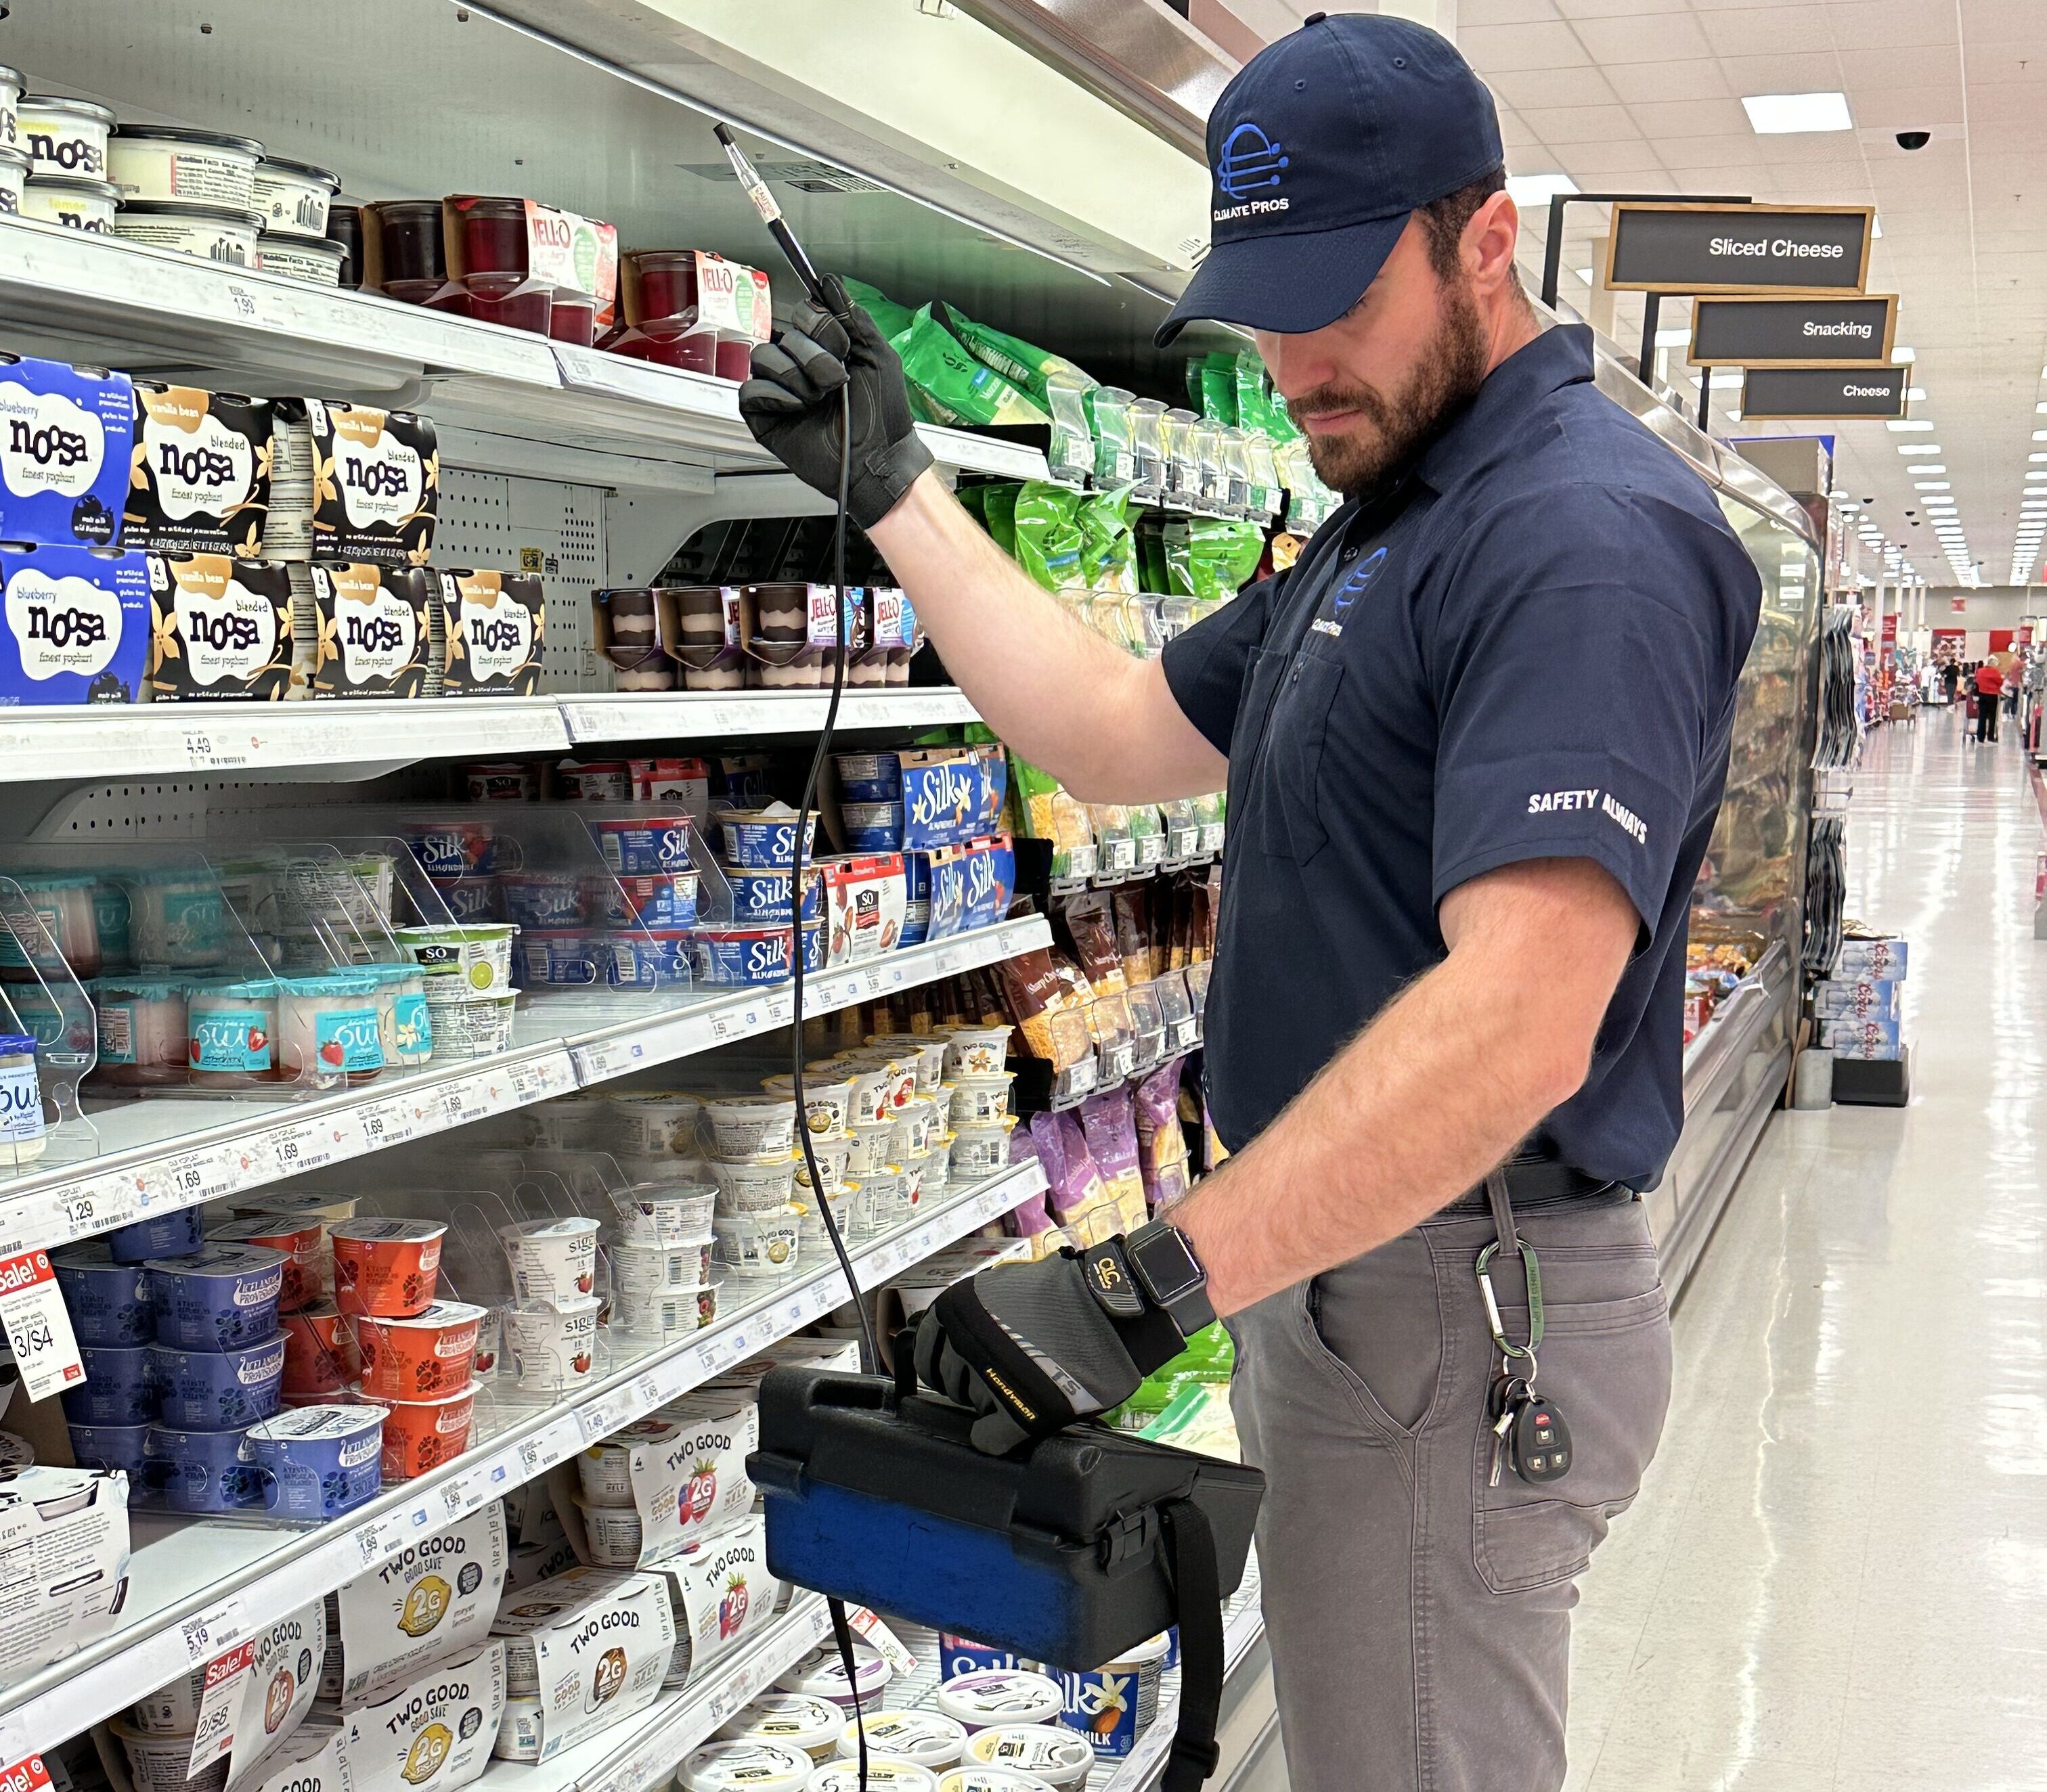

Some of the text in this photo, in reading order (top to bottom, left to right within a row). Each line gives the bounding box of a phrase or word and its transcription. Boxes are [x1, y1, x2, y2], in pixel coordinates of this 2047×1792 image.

[1214, 198, 1290, 221] CLIMATE PROS
[1709, 238, 1844, 259] Sliced Cheese
[1803, 321, 1872, 339] Snacking
[1843, 384, 1891, 398] Cheese
[10, 419, 89, 467] noosa
[211, 434, 245, 451] blended
[160, 443, 236, 487] noosa
[346, 457, 409, 497] noosa
[17, 587, 58, 604] blueberry
[236, 600, 268, 612] blended
[28, 606, 106, 648] noosa
[190, 611, 261, 650] noosa
[347, 616, 403, 652] noosa
[471, 619, 521, 652] noosa
[187, 738, 211, 753] 4.49
[494, 778, 511, 787] SO
[921, 763, 957, 825] Silk
[1528, 789, 1648, 845] SAFETY ALWAYS
[423, 832, 468, 864] Silk
[749, 876, 793, 909] Silk
[967, 850, 996, 908] Silk
[452, 886, 492, 918] Silk
[862, 892, 874, 905] SO
[426, 947, 447, 959] SO
[747, 936, 787, 972] Silk
[362, 1119, 384, 1137] 1.69
[275, 1143, 299, 1162] 1.69
[175, 1171, 201, 1190] 1.69
[66, 1201, 94, 1222] 1.29
[986, 1368, 1037, 1421] Handyman
[1052, 1366, 1082, 1396] TS
[667, 1433, 731, 1471] TWO GOOD
[691, 1477, 712, 1502] 2G
[378, 1536, 466, 1584] TWO GOOD
[706, 1547, 755, 1588] TWO GOOD
[412, 1588, 441, 1618] 2G
[728, 1590, 746, 1617] 2G
[272, 1621, 302, 1647] GOOD
[571, 1611, 640, 1655] TWO GOOD
[206, 1649, 243, 1685] Sale!
[598, 1657, 622, 1688] 2G
[386, 1683, 470, 1734] TWO GOOD
[414, 1735, 443, 1767] 2G
